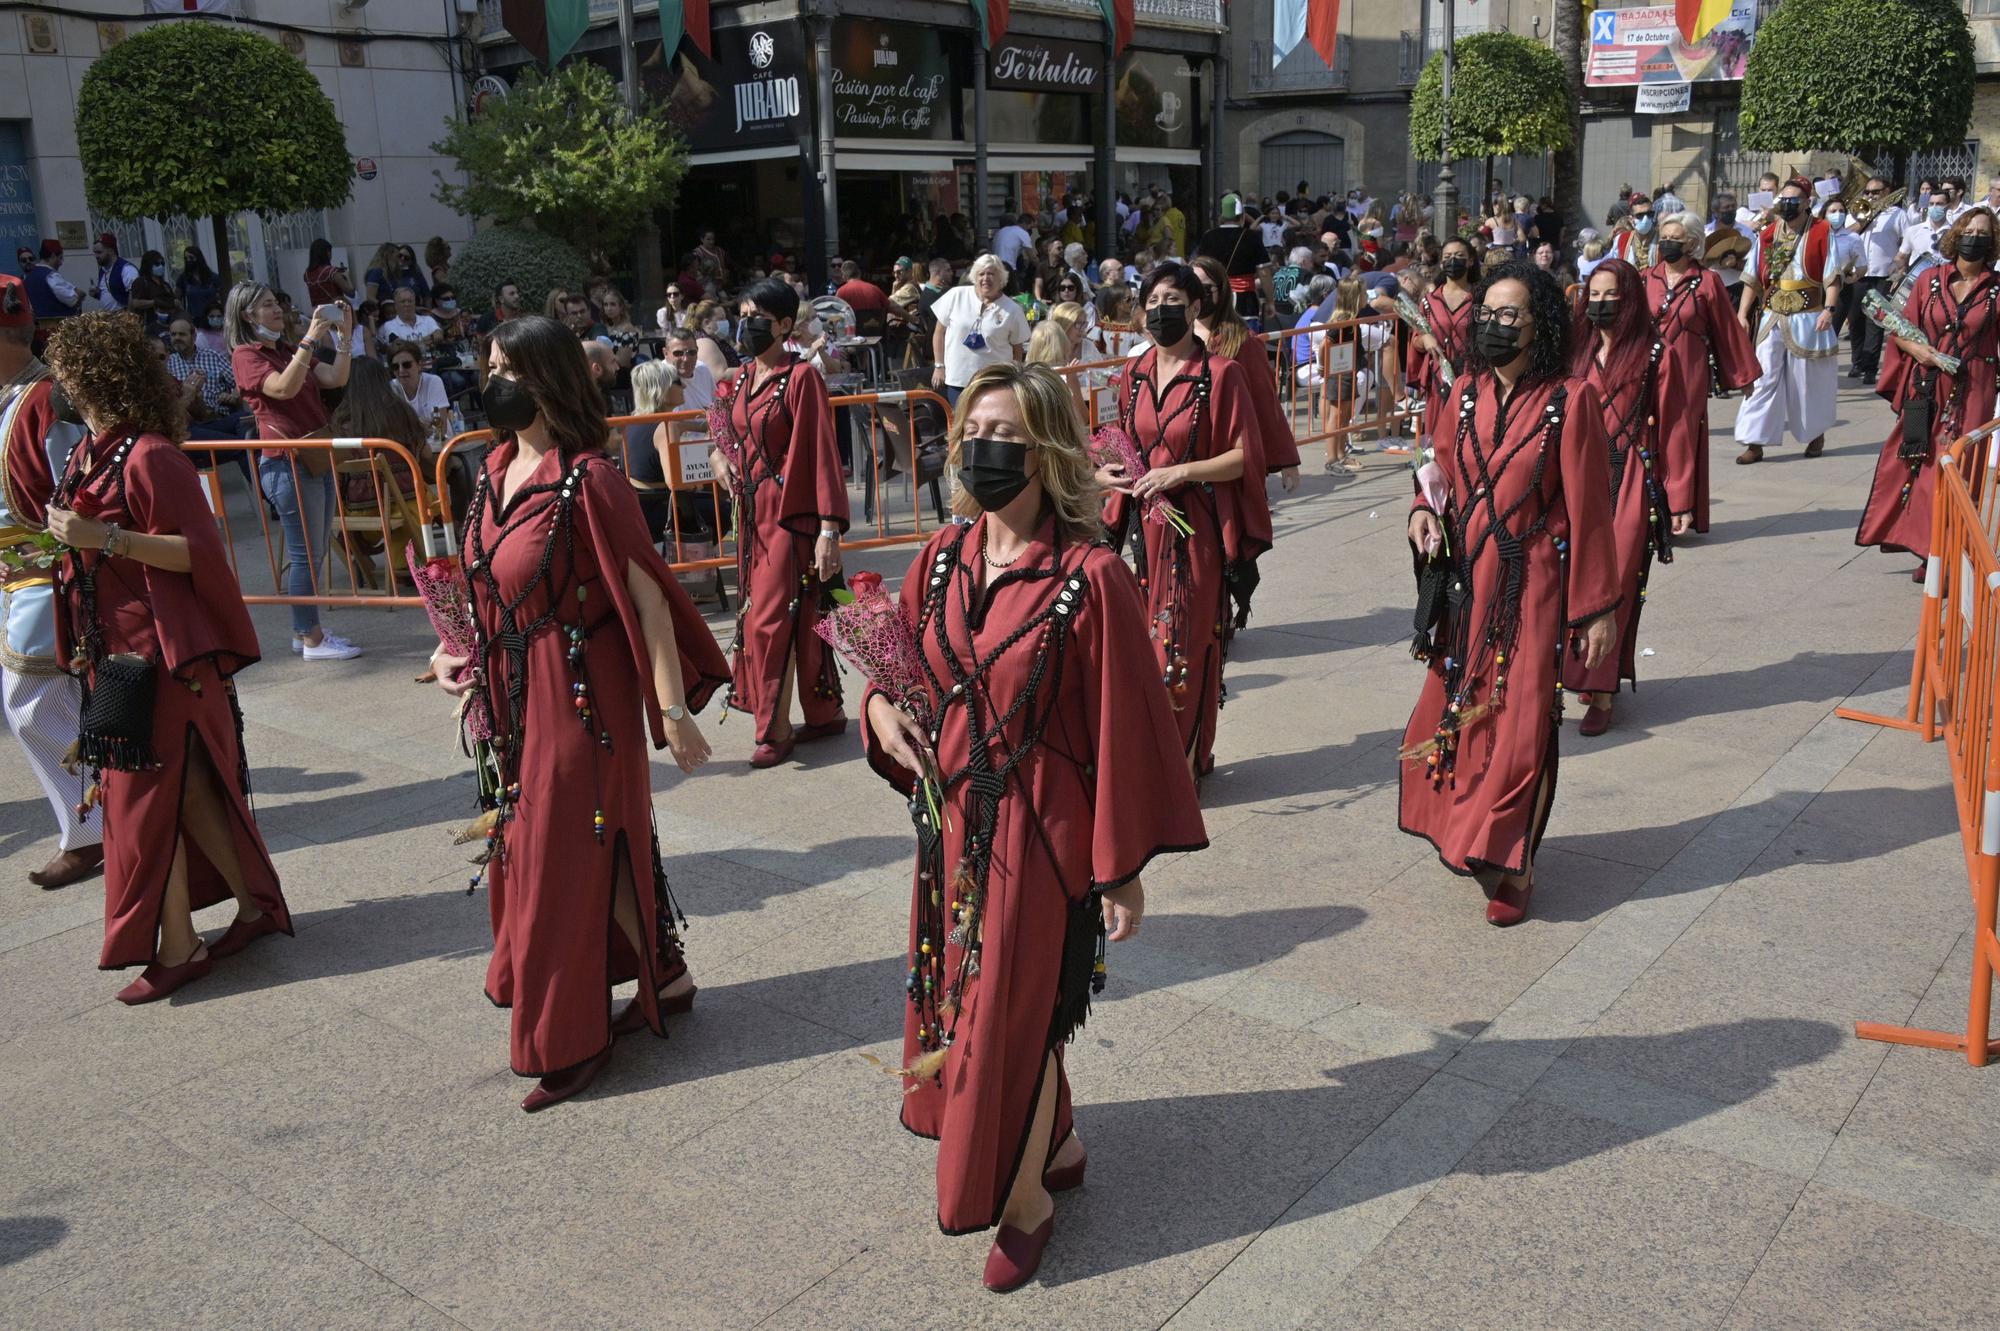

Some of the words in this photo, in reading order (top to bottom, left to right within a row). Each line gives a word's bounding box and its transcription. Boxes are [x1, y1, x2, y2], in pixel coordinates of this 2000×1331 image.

[1594, 15, 1615, 40] X
[1627, 34, 1635, 43] 17
[1635, 34, 1644, 42] de
[1644, 32, 1670, 42] Octubre
[874, 49, 899, 68] JURADO
[995, 47, 1099, 85] Tertulia
[866, 83, 898, 106] por
[897, 74, 914, 98] el
[1641, 86, 1689, 97] INSCRIPCIONES
[836, 103, 881, 125] Passion
[877, 105, 898, 129] for
[901, 106, 931, 130] Coffee
